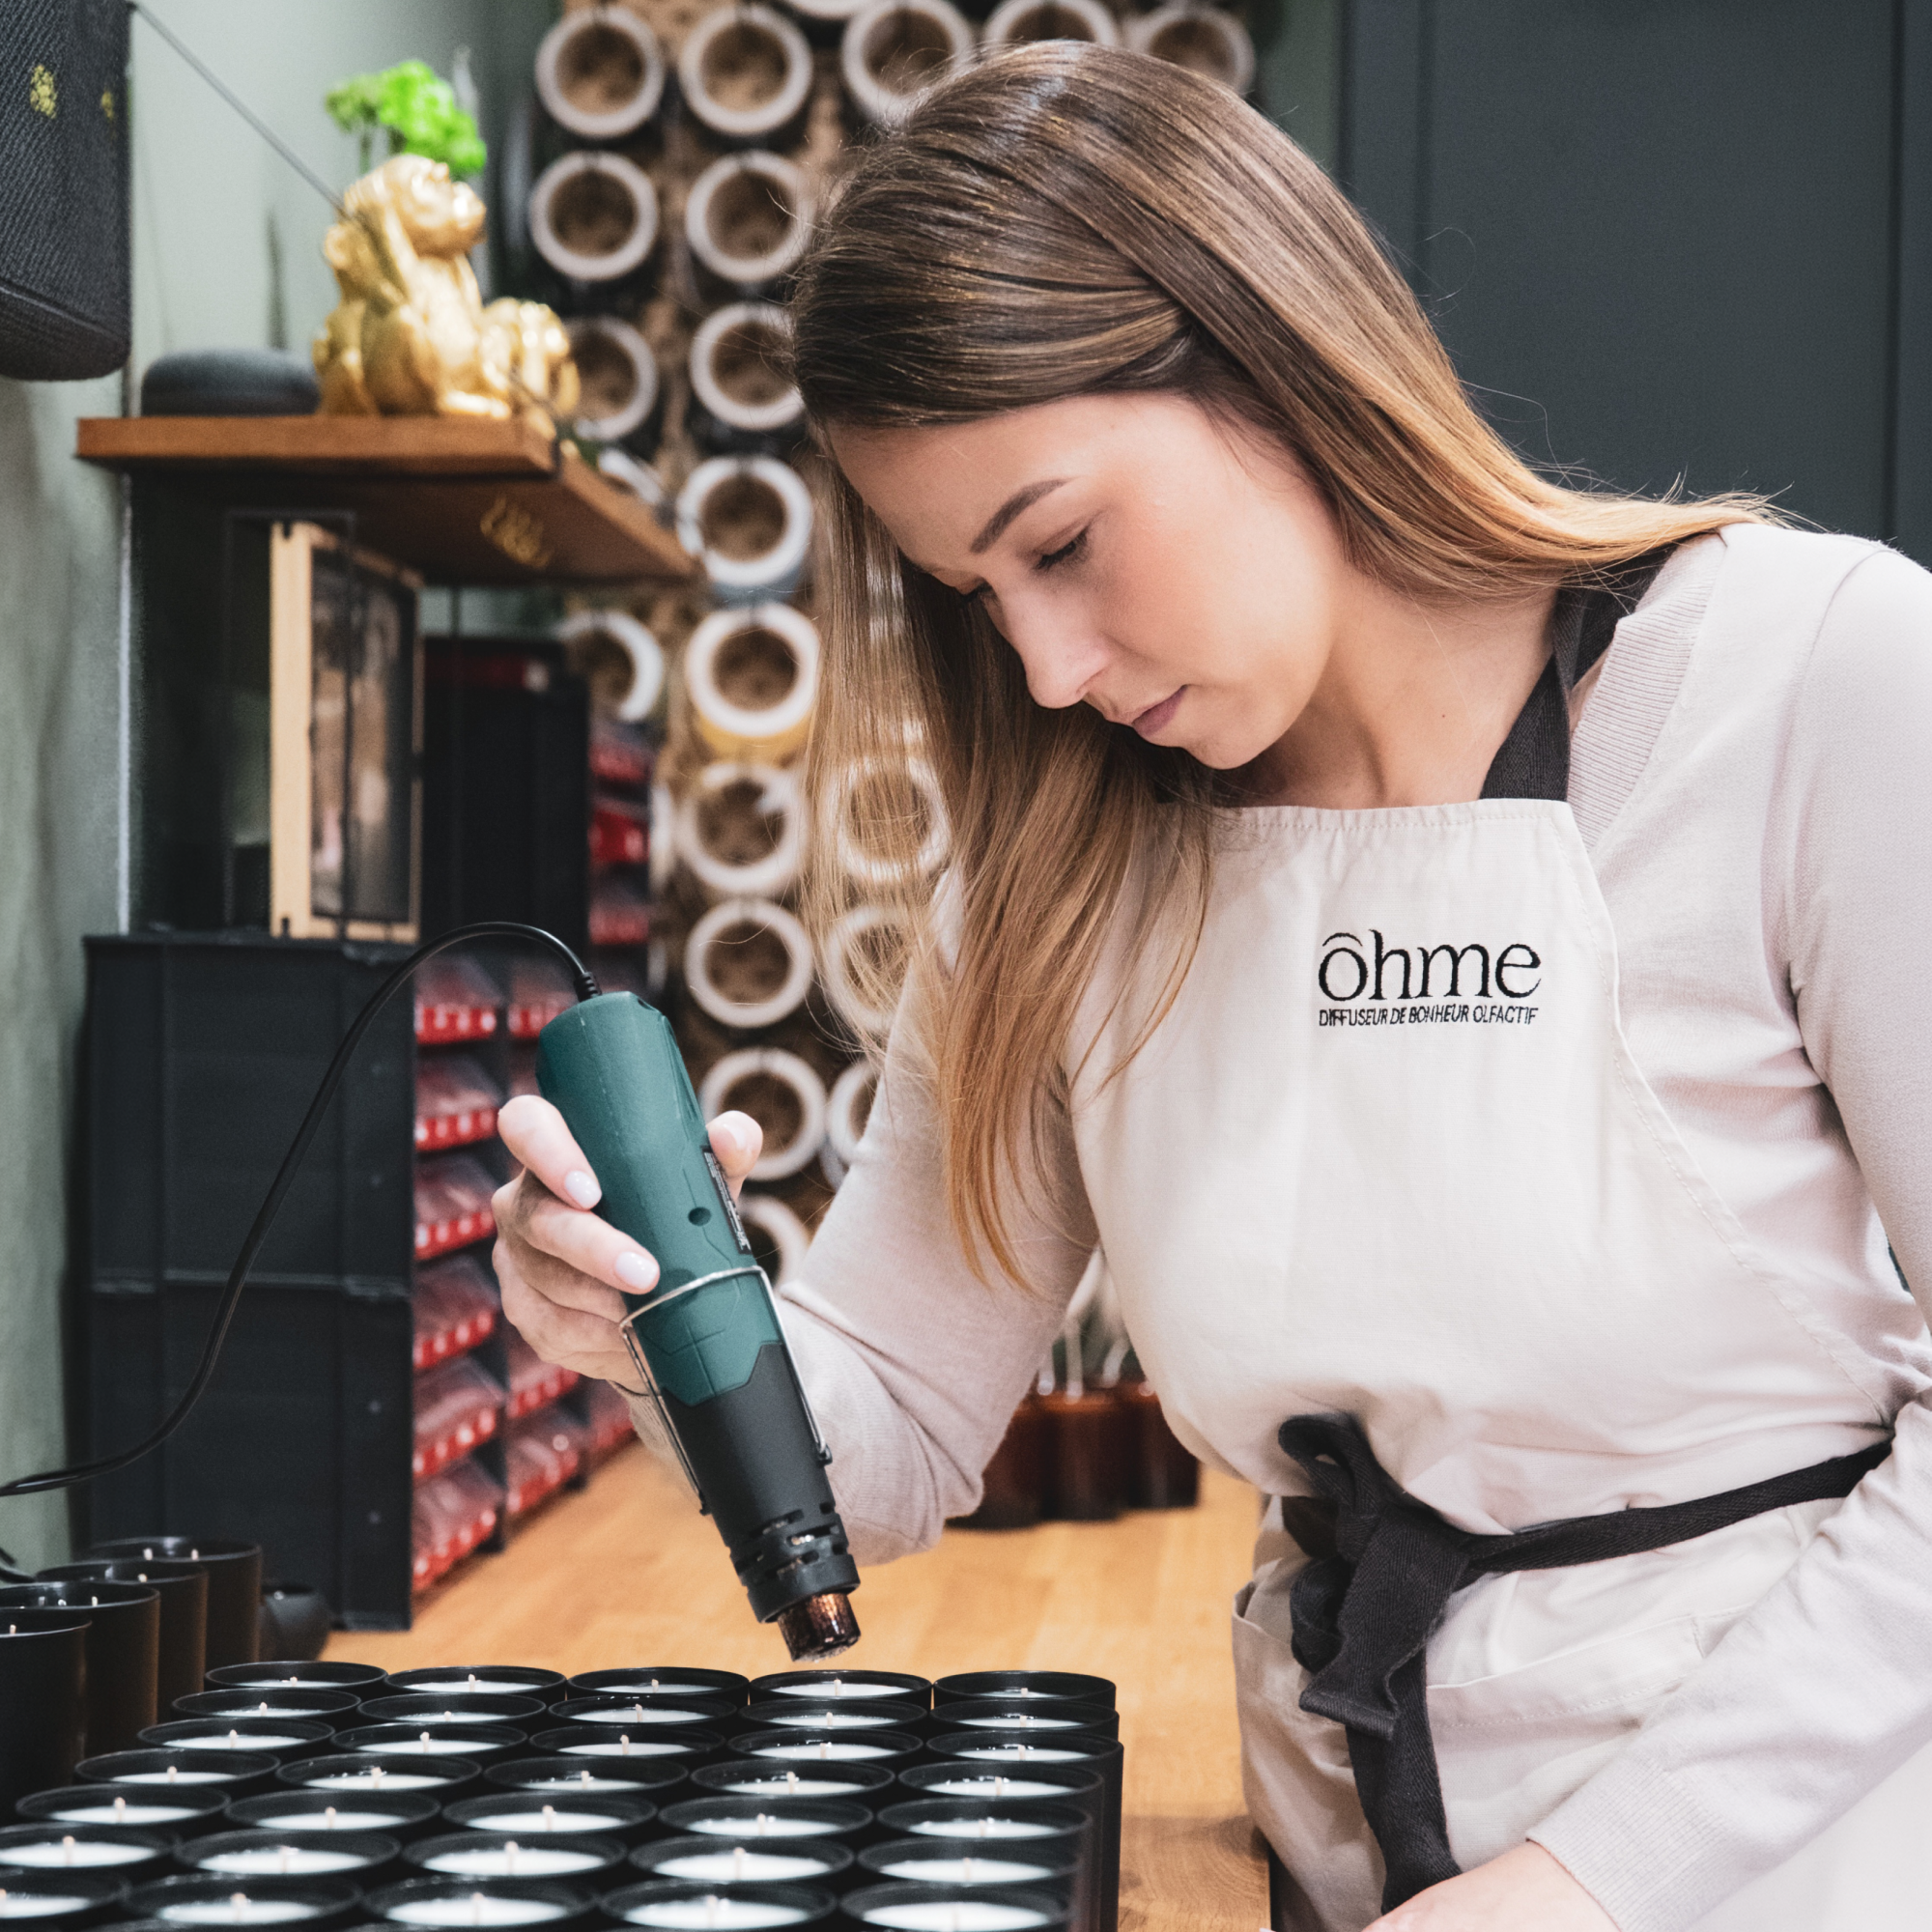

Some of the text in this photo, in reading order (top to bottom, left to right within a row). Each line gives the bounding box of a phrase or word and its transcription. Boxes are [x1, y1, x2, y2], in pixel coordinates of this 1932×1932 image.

[1319, 929, 1542, 1001] ôhme
[1319, 1004, 1539, 1027] DIFFUSEUR DE BONHEUR OLFACTIF
